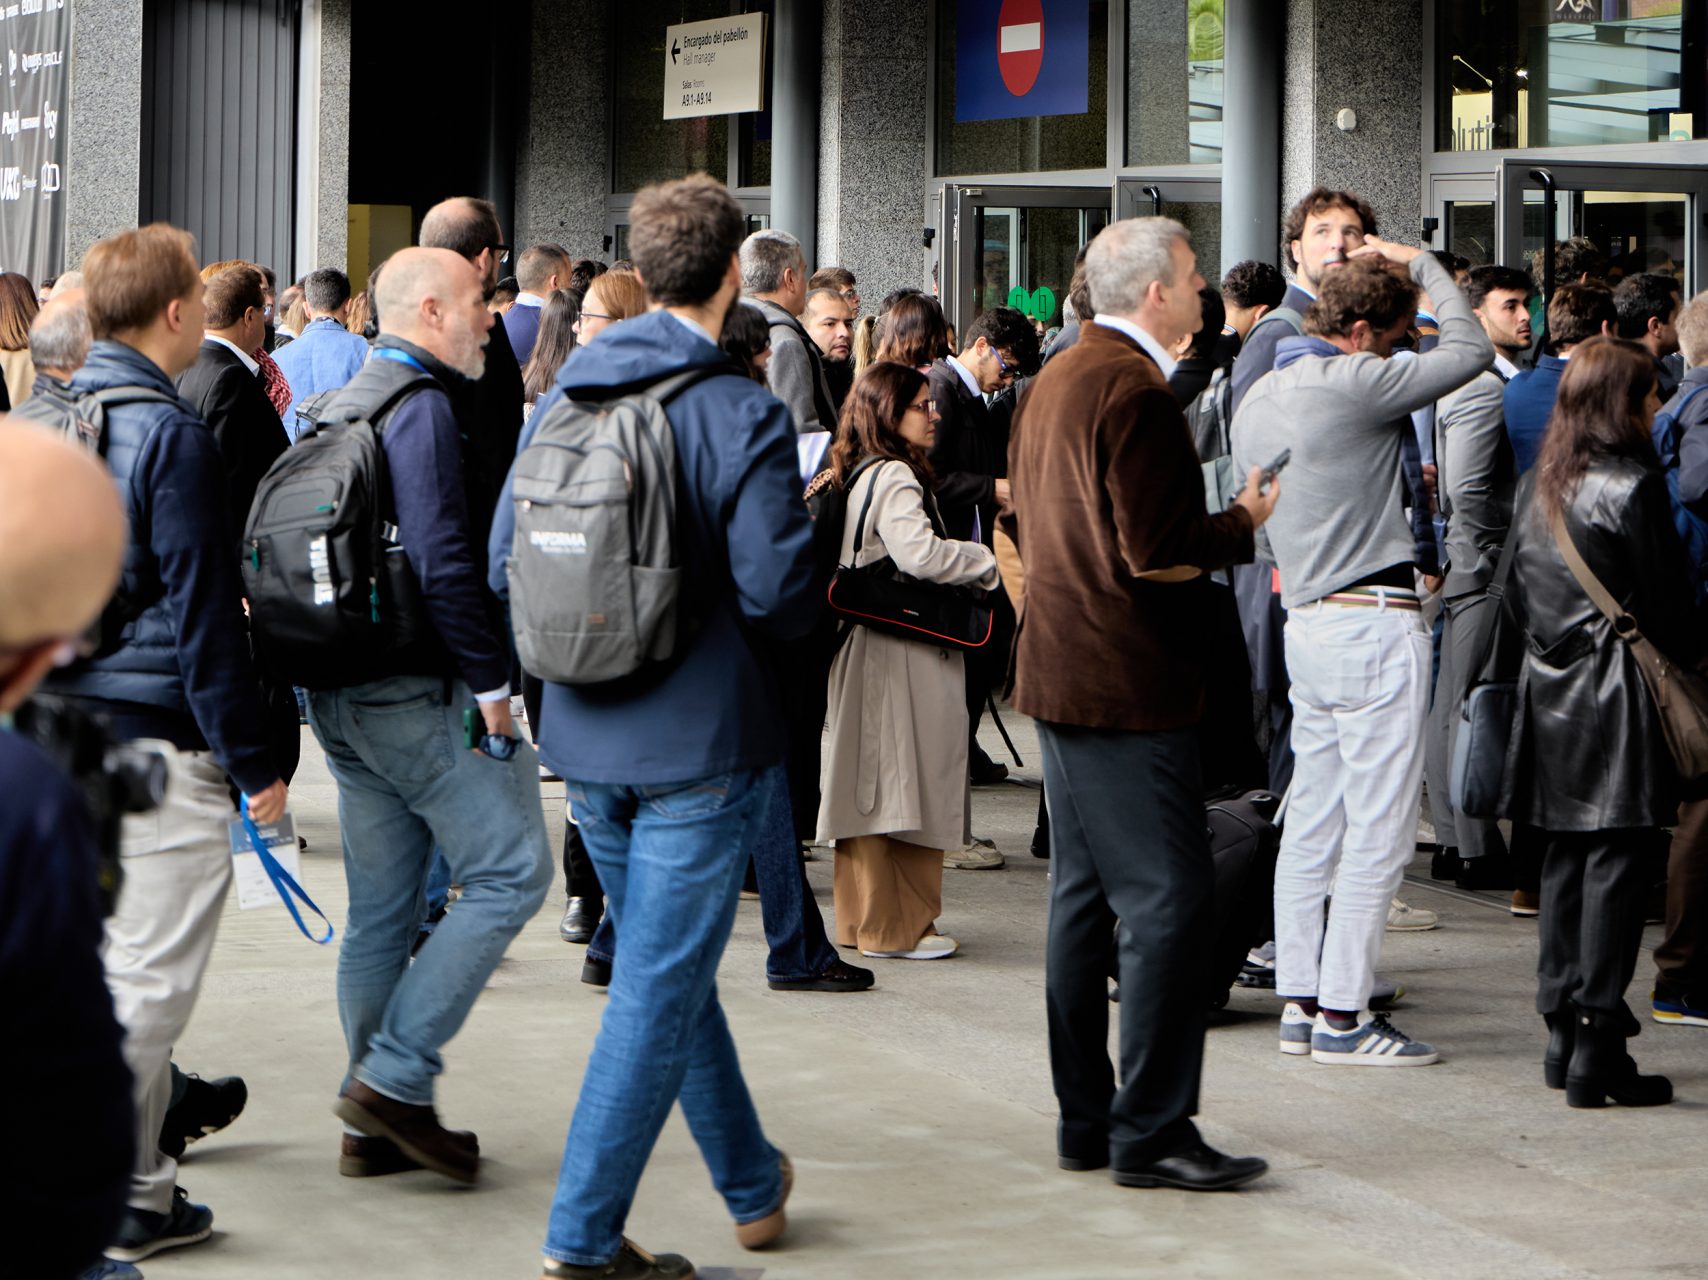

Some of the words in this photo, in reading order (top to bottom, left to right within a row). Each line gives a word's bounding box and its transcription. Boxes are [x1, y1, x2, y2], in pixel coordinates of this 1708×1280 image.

[684, 32, 711, 50] Encargado
[713, 29, 722, 44] del
[723, 26, 748, 46] pabellón
